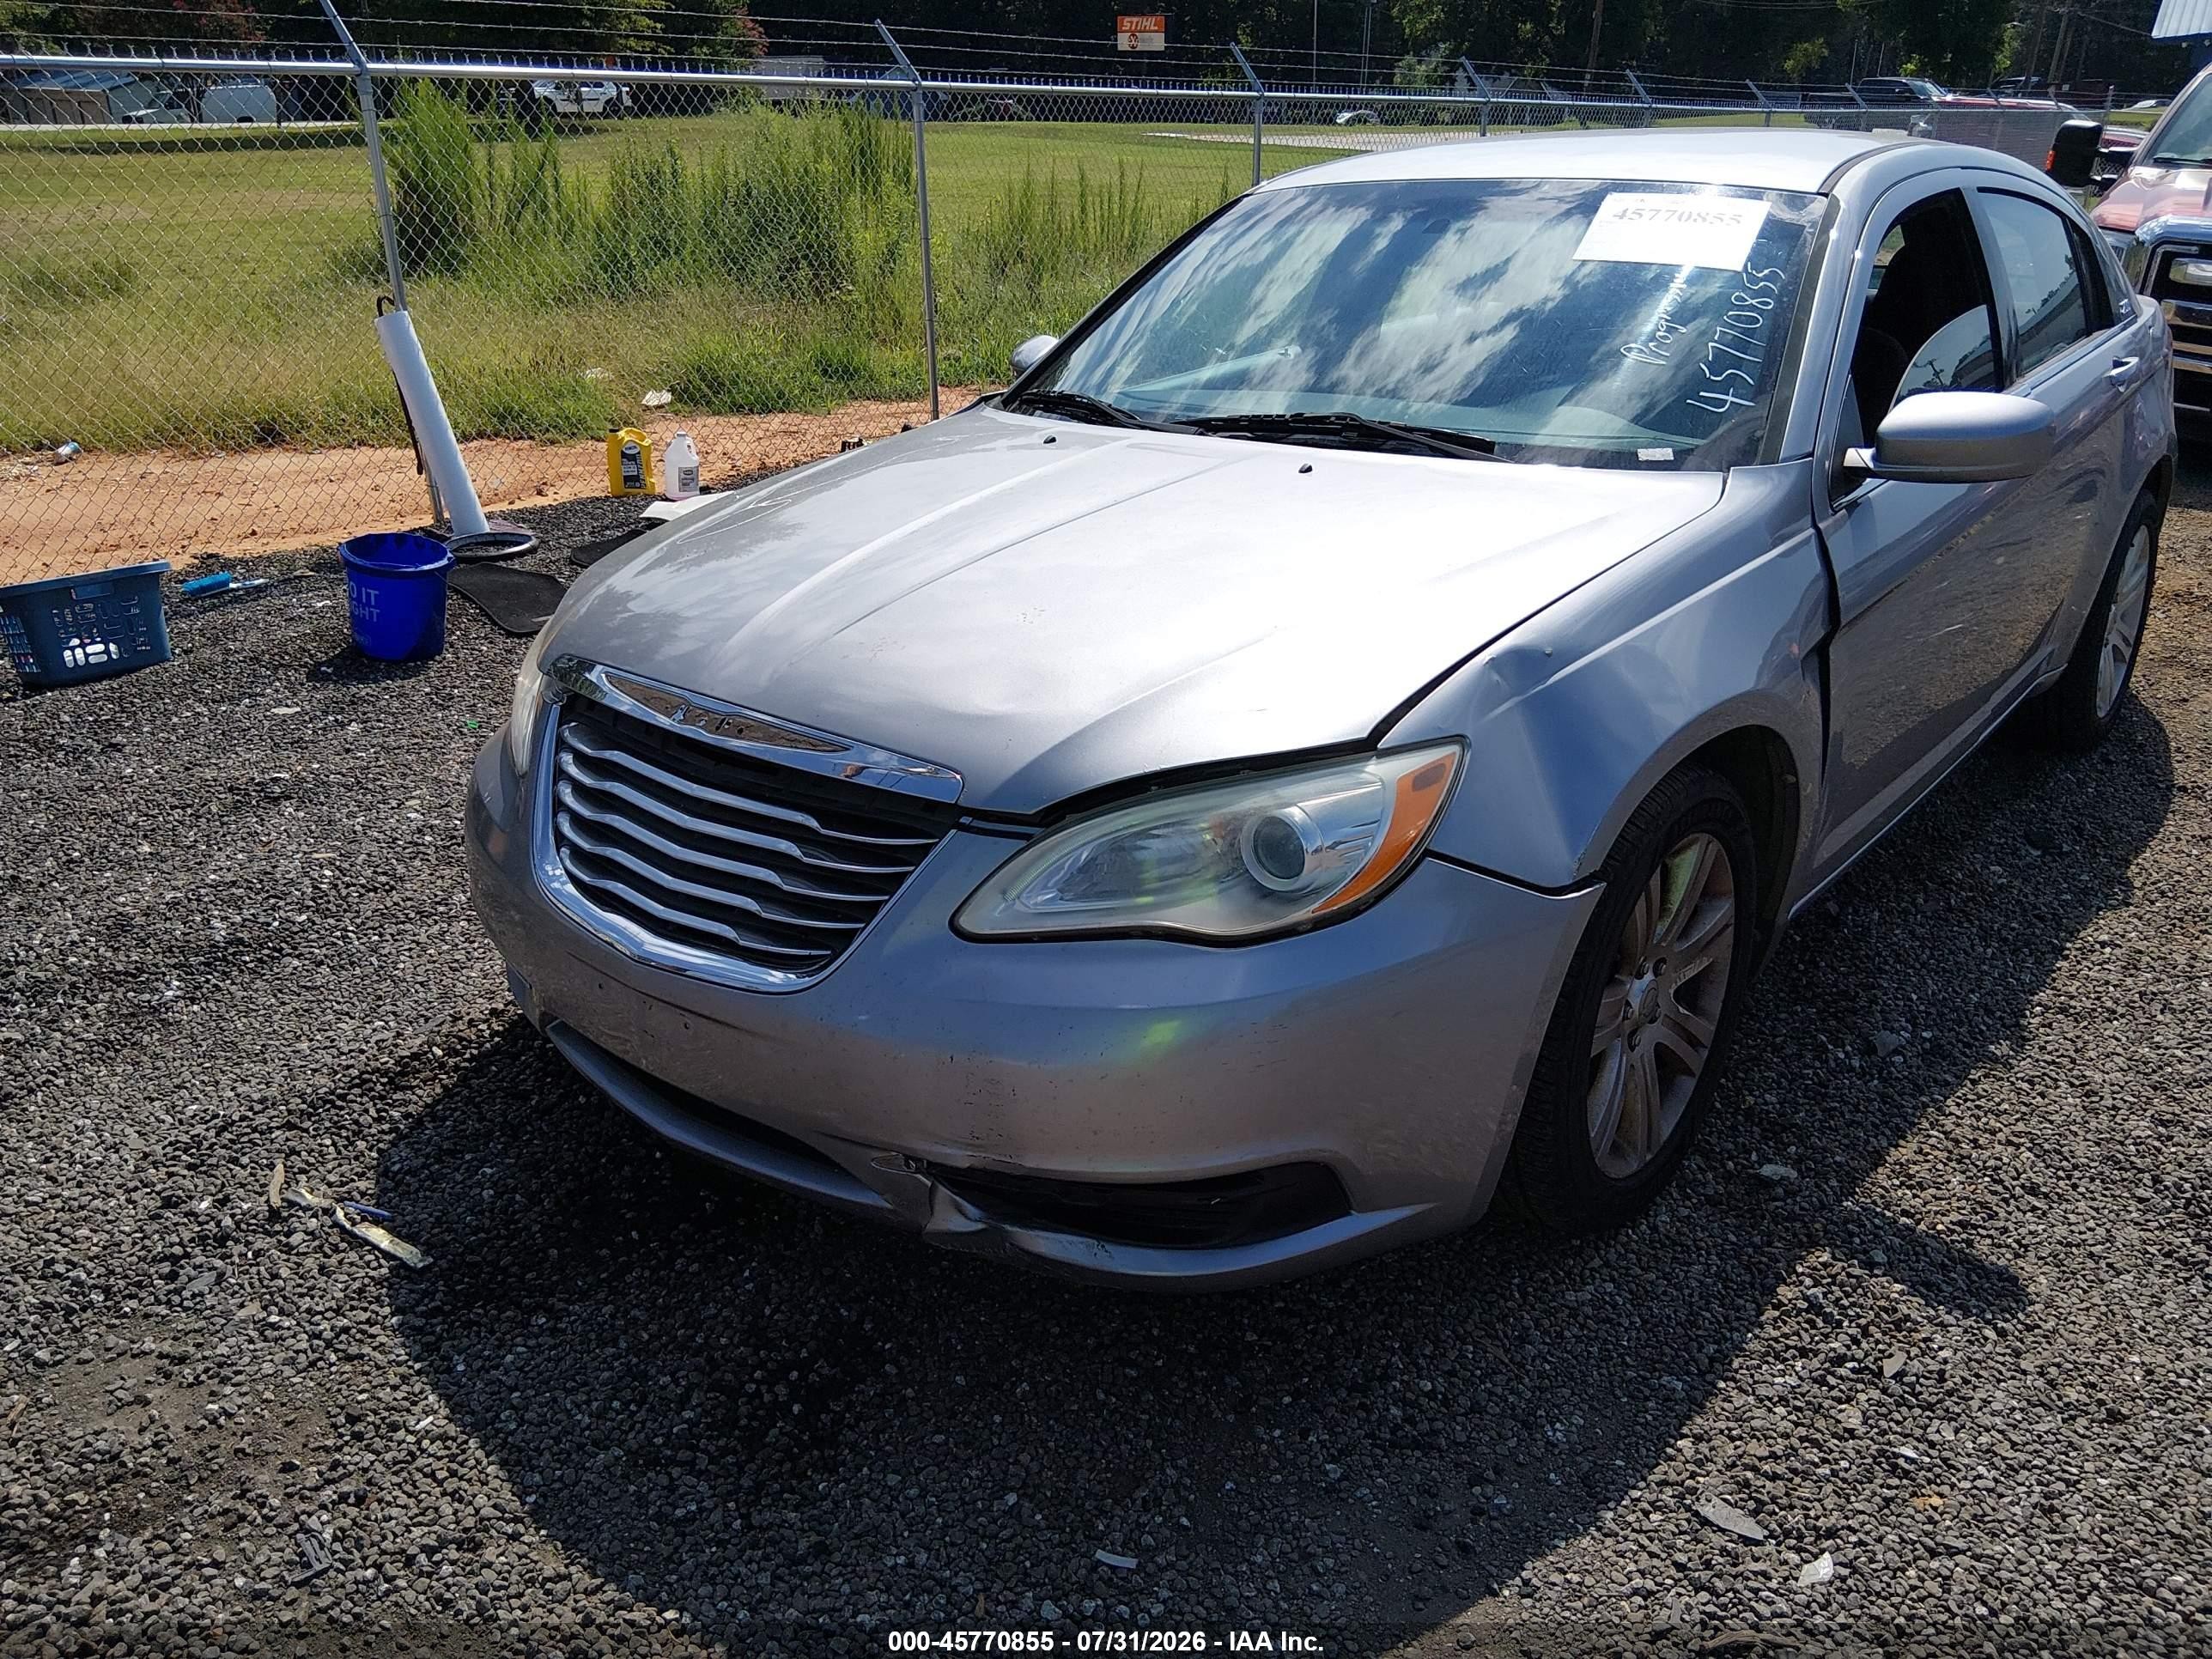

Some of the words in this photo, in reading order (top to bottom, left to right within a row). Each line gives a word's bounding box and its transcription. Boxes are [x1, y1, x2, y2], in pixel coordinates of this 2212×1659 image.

[1121, 17, 1159, 30] STIHL
[1613, 207, 1743, 226] 45770855
[1686, 261, 1785, 413] 45770855
[362, 586, 380, 605] IT
[350, 600, 381, 622] GHT
